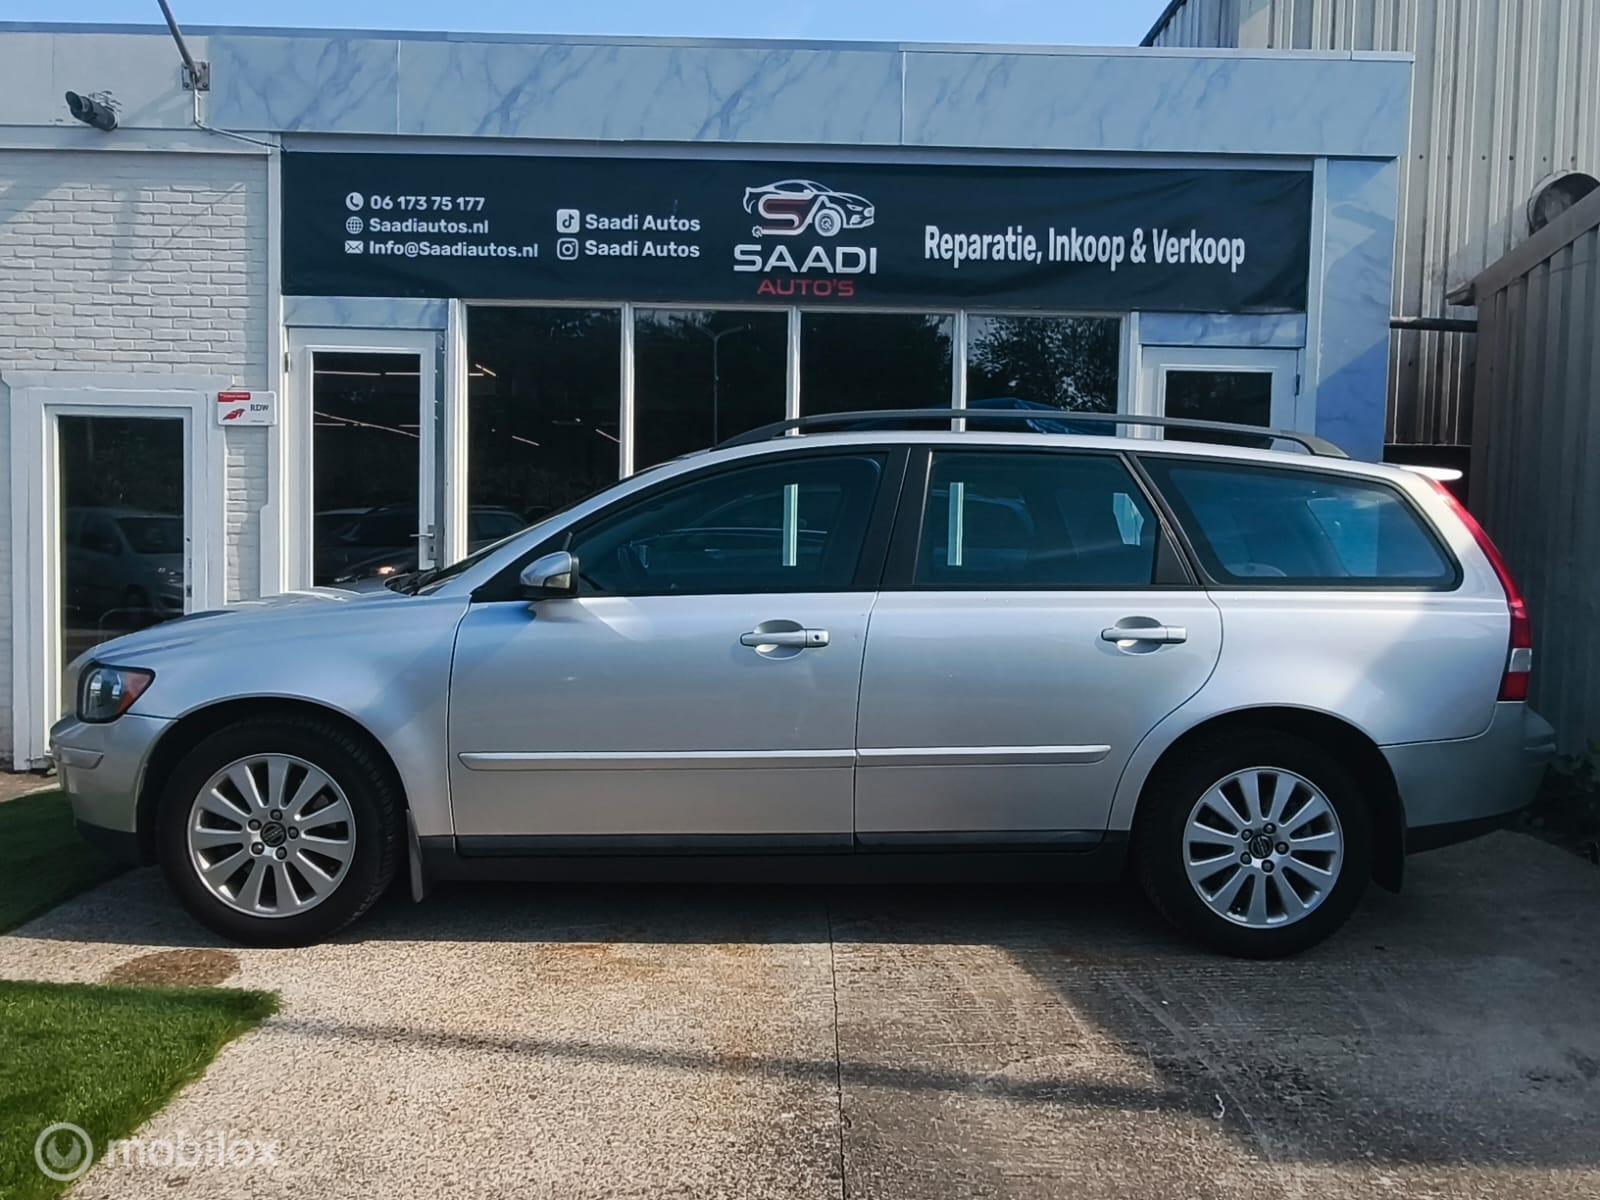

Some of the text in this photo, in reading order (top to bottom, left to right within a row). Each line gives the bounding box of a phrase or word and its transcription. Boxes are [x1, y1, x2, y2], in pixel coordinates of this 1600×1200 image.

[370, 195, 485, 211] 06 173 75 177
[369, 218, 489, 234] Saadiautos.nl
[585, 213, 701, 232] Saadi Autos
[369, 240, 538, 258] Info@Saadiautos.nl
[585, 239, 701, 258] Saadi Autos
[924, 225, 1245, 273] Reparatie, Inkoop & Verkoop
[733, 244, 877, 274] SAADI
[756, 278, 855, 296] AUTO'S
